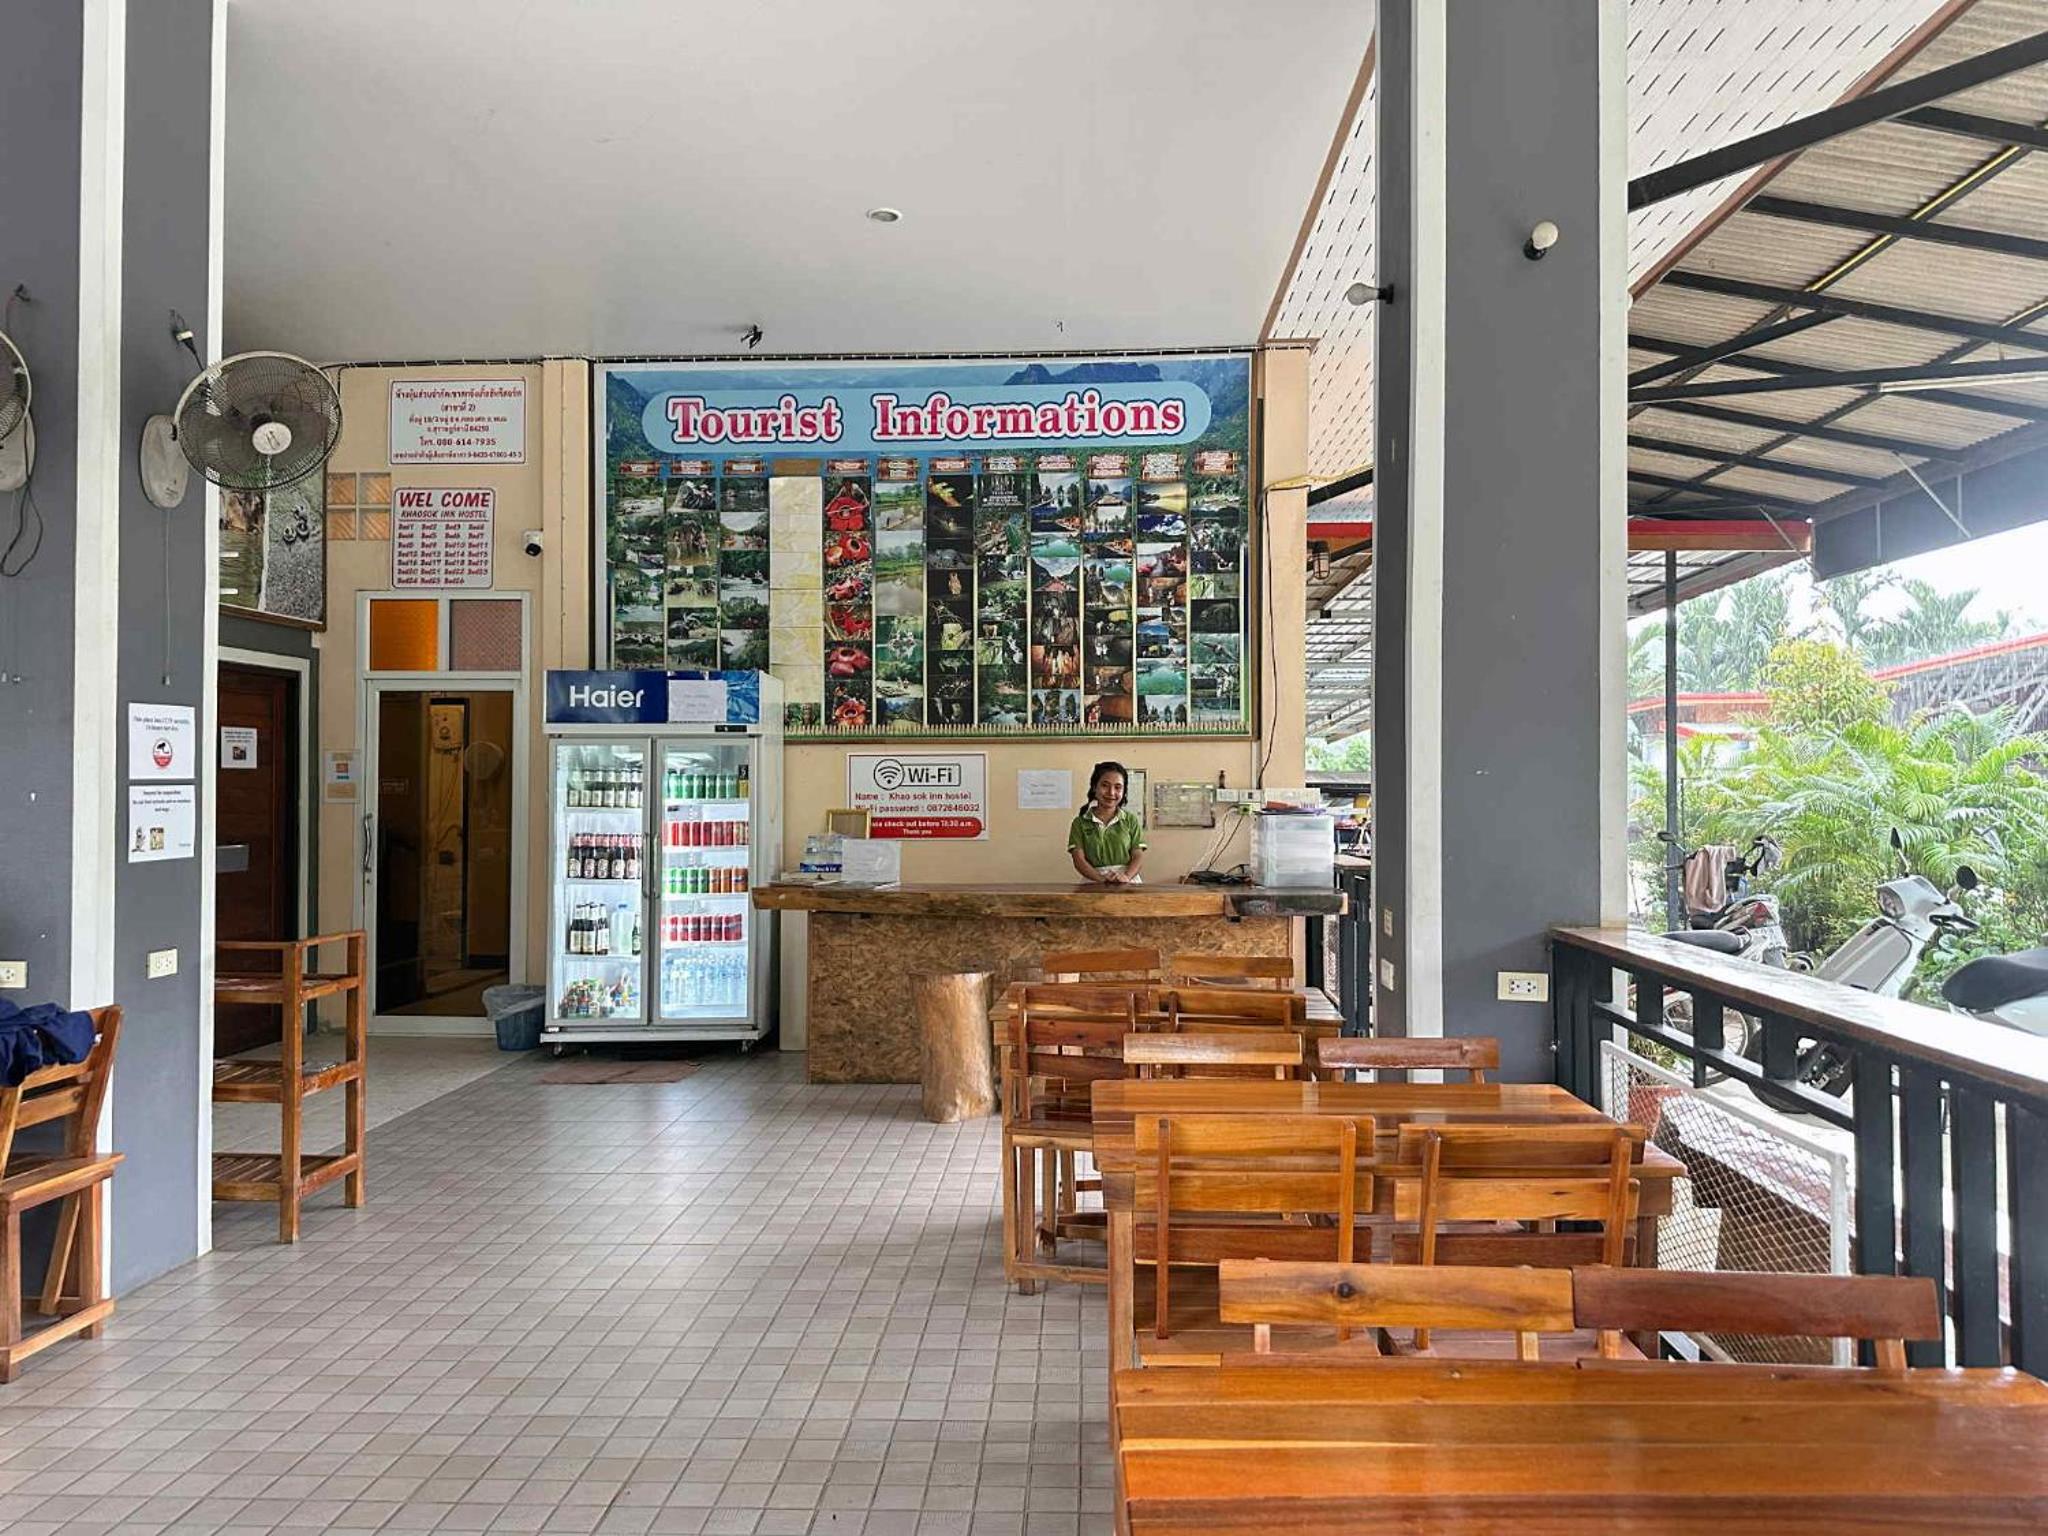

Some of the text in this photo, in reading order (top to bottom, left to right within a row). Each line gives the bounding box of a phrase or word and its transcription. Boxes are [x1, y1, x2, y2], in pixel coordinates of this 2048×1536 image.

[669, 391, 1184, 441] Tourist Informations
[399, 492, 491, 507] WEL COME
[458, 510, 487, 518] HOSTEL
[568, 685, 645, 708] Haier
[908, 768, 952, 783] Wi-Fi
[889, 792, 910, 800] Khao
[913, 792, 926, 800] sok
[929, 792, 943, 800] inn
[945, 791, 972, 800] hostel
[880, 805, 920, 813] password
